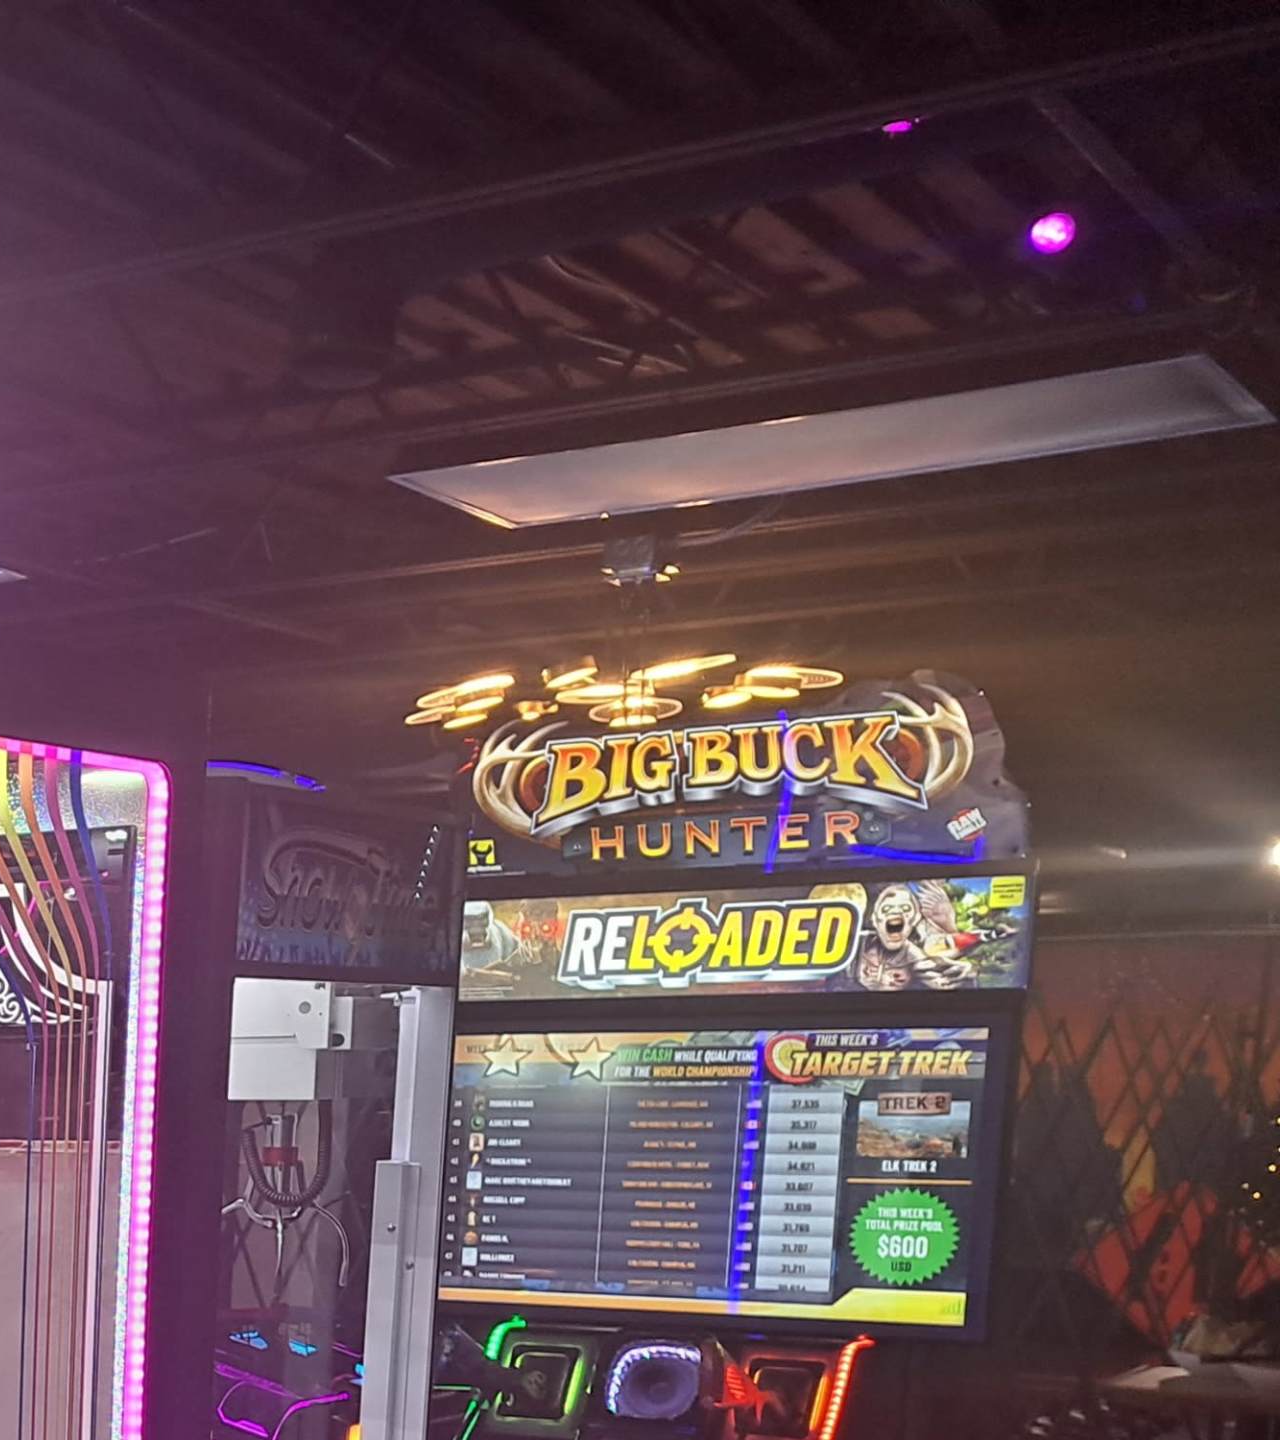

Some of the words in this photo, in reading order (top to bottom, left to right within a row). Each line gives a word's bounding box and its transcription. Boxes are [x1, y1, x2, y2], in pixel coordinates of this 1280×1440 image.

[538, 739, 675, 824] BIG
[687, 715, 923, 798] BUCK
[590, 811, 862, 861] HUNTER
[566, 900, 855, 975] RELOADED
[815, 1034, 838, 1046] THIS
[840, 1033, 879, 1046] WEEK'S
[643, 1048, 672, 1060] CASH
[674, 1050, 702, 1061] WHILE
[791, 1050, 896, 1076] TARGET
[897, 1050, 973, 1076] TREK
[633, 1066, 651, 1076] THE
[653, 1065, 683, 1077] WORLD
[882, 1095, 928, 1110] TREK
[903, 1160, 927, 1173] TREK
[865, 1219, 891, 1230] TOTAL
[893, 1220, 919, 1231] PRIZE
[877, 1234, 929, 1258] $600
[891, 1261, 912, 1272] USD
